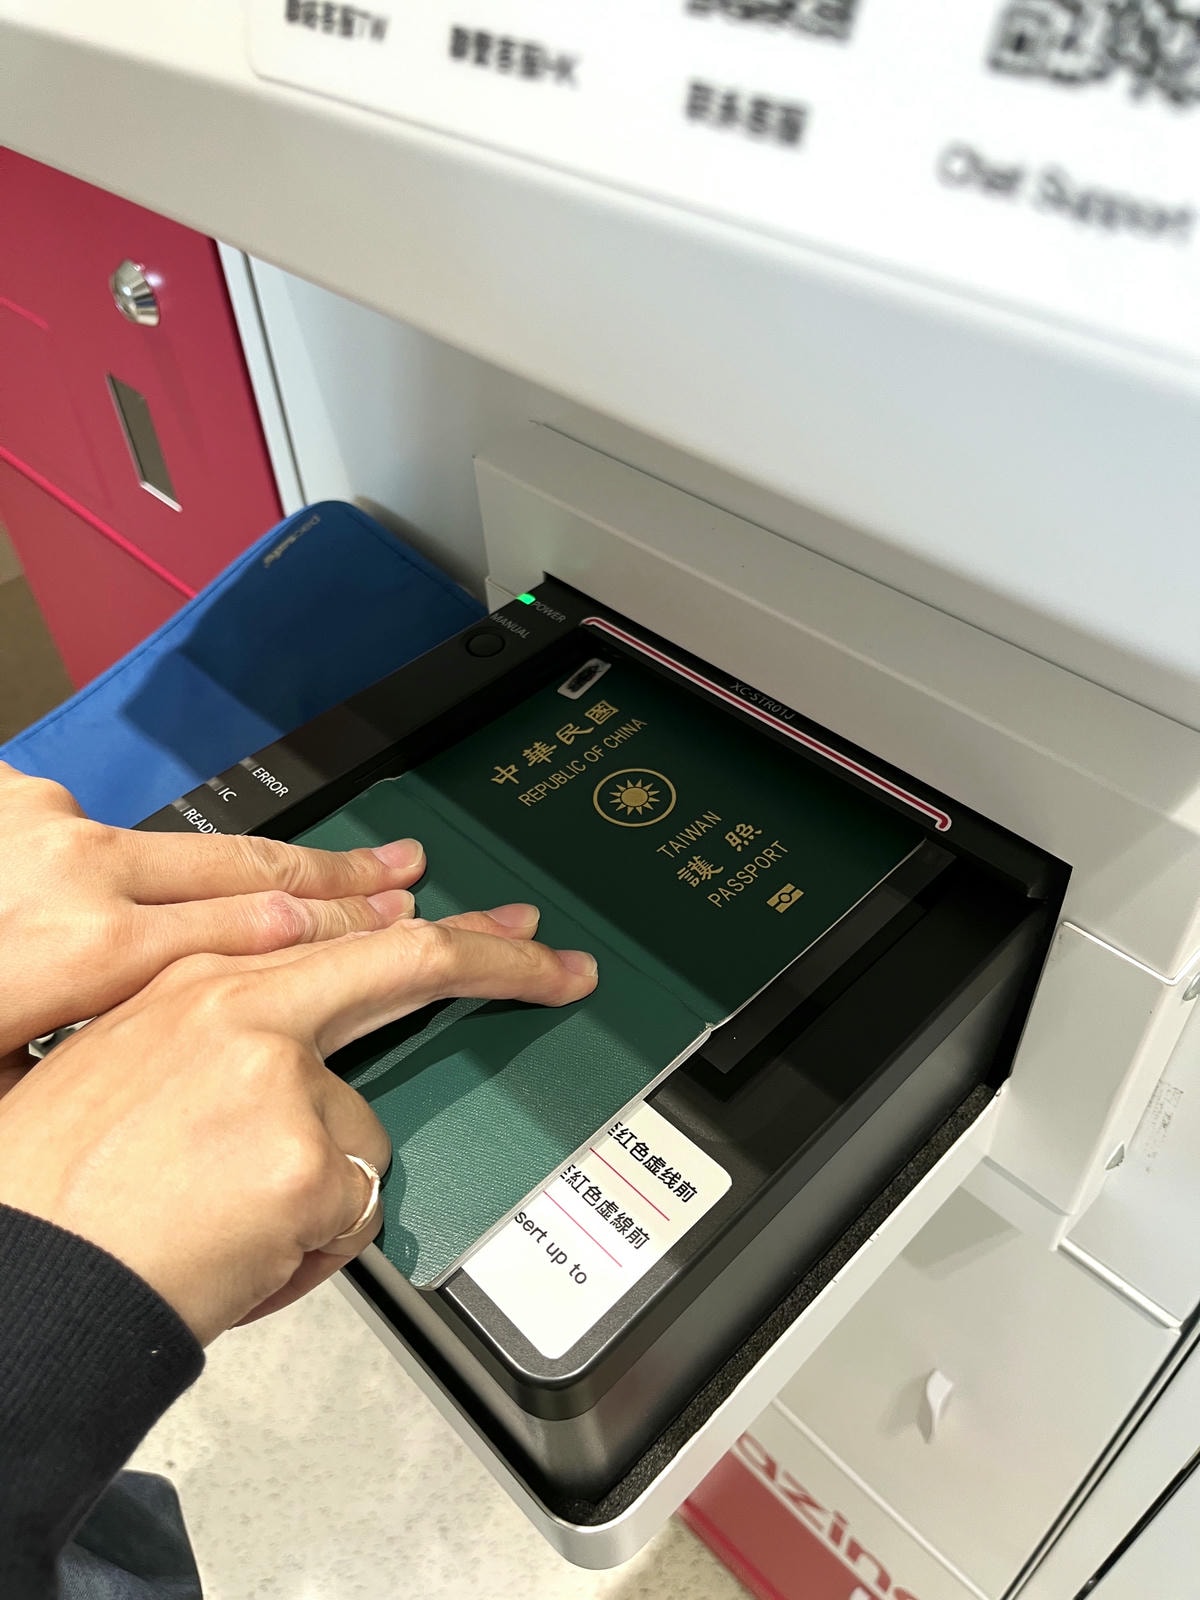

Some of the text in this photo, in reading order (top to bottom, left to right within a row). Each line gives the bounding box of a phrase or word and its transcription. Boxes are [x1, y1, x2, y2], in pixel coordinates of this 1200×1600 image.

[489, 612, 532, 640] MANUAL
[531, 600, 567, 624] POWER
[730, 681, 795, 721] XC-STR01J
[490, 700, 619, 785] 中華民國
[518, 718, 648, 807] REPUBLIC OF CHINA
[218, 787, 237, 802] IC
[252, 767, 289, 798] ERROR
[656, 811, 722, 859] TAIWAN
[676, 822, 762, 888] 護照
[707, 840, 791, 908] PASSPORT
[546, 1242, 568, 1265] up
[569, 1263, 588, 1285] to
[736, 1432, 921, 1600] azin
